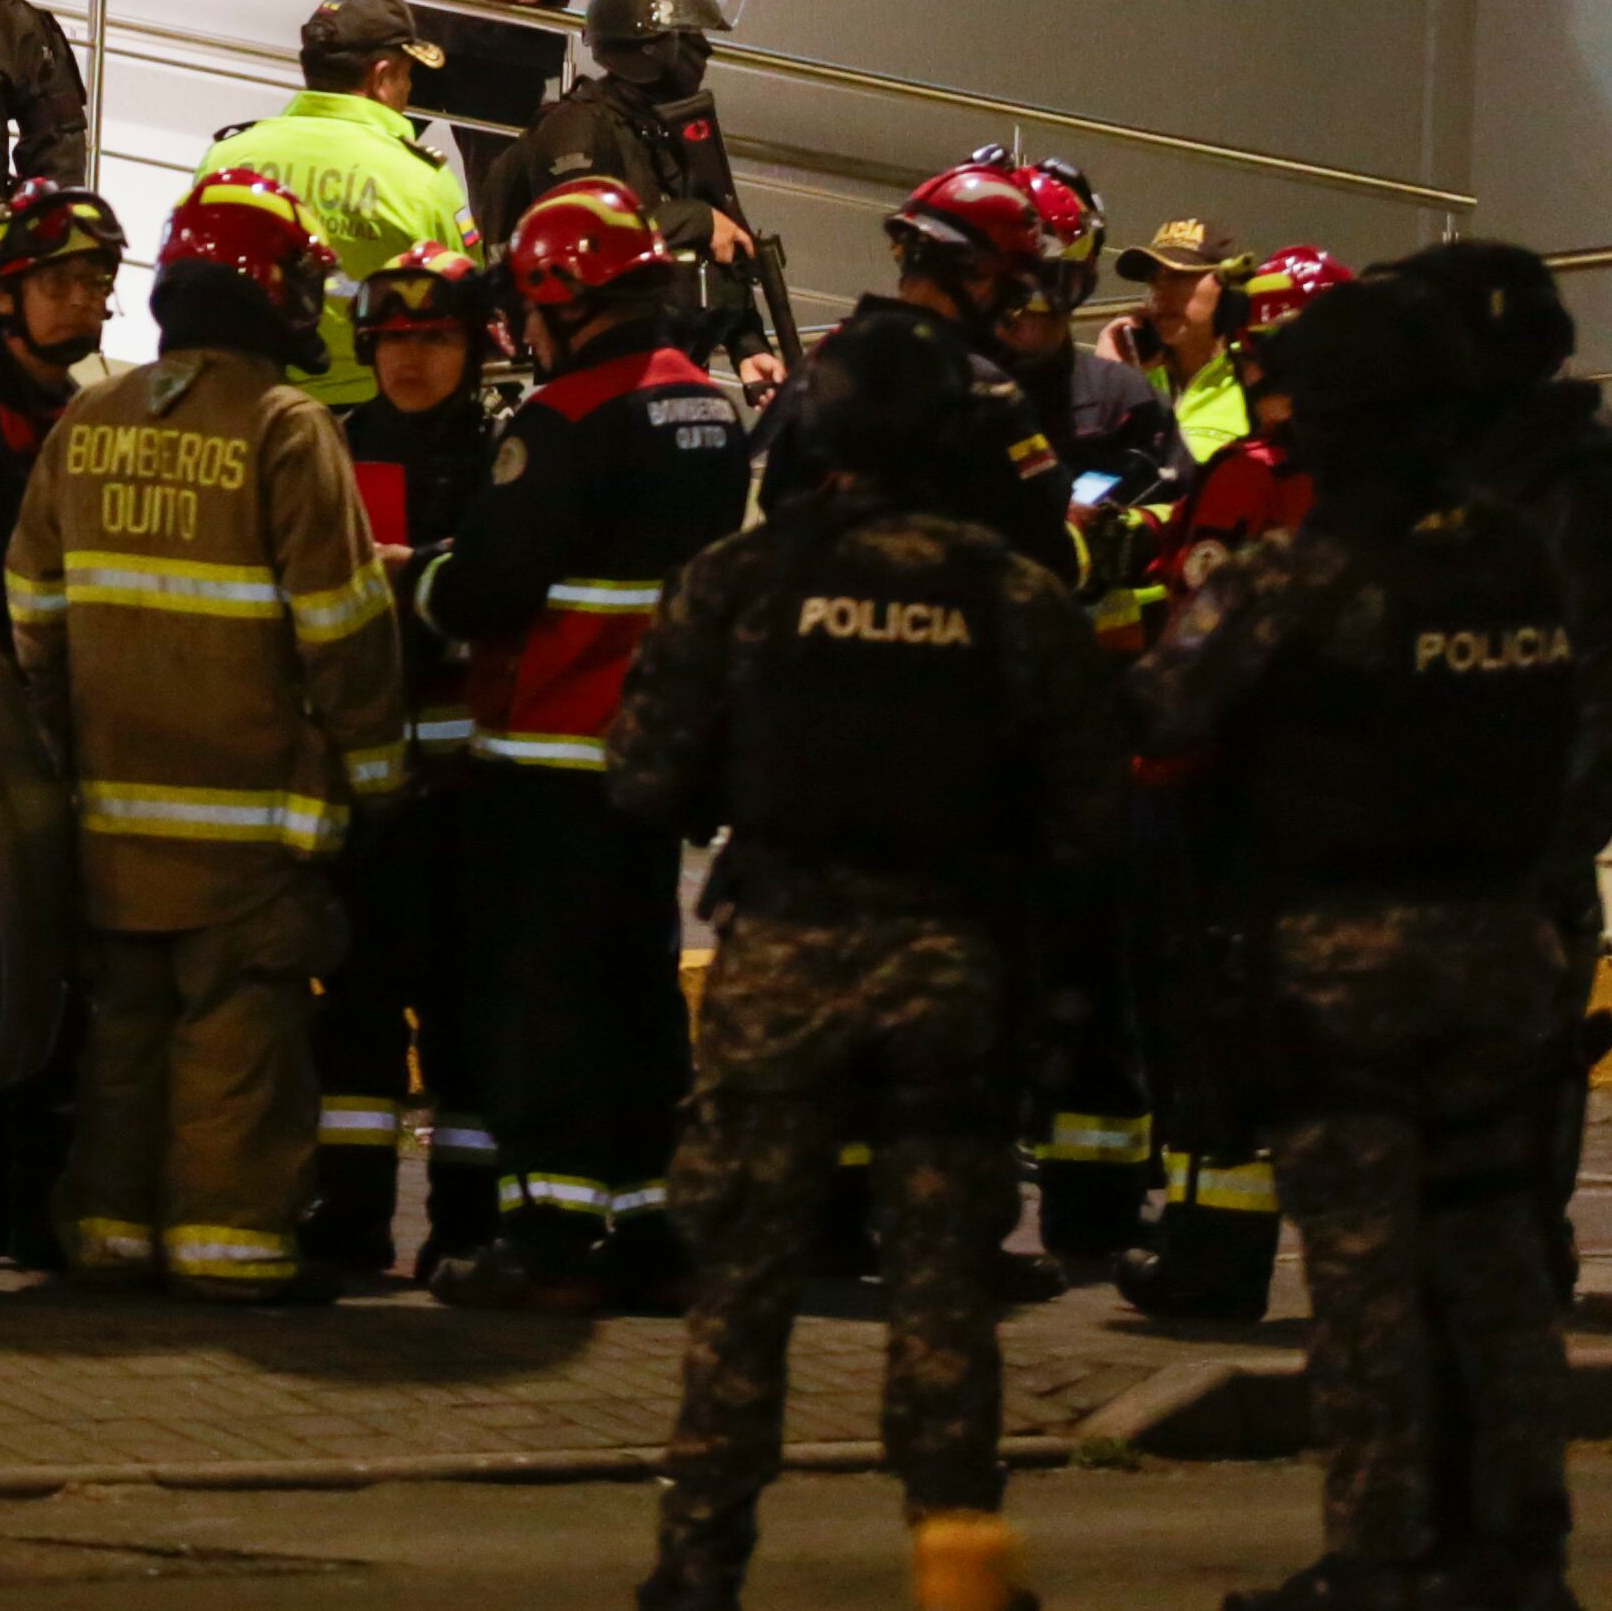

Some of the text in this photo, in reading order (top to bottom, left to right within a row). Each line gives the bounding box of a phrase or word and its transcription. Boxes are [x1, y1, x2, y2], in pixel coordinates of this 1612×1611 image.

[238, 162, 380, 220] OLICÍA
[67, 424, 249, 490] BOMBEROS
[797, 596, 971, 645] POLICIA
[1415, 626, 1575, 672] POLICIA
